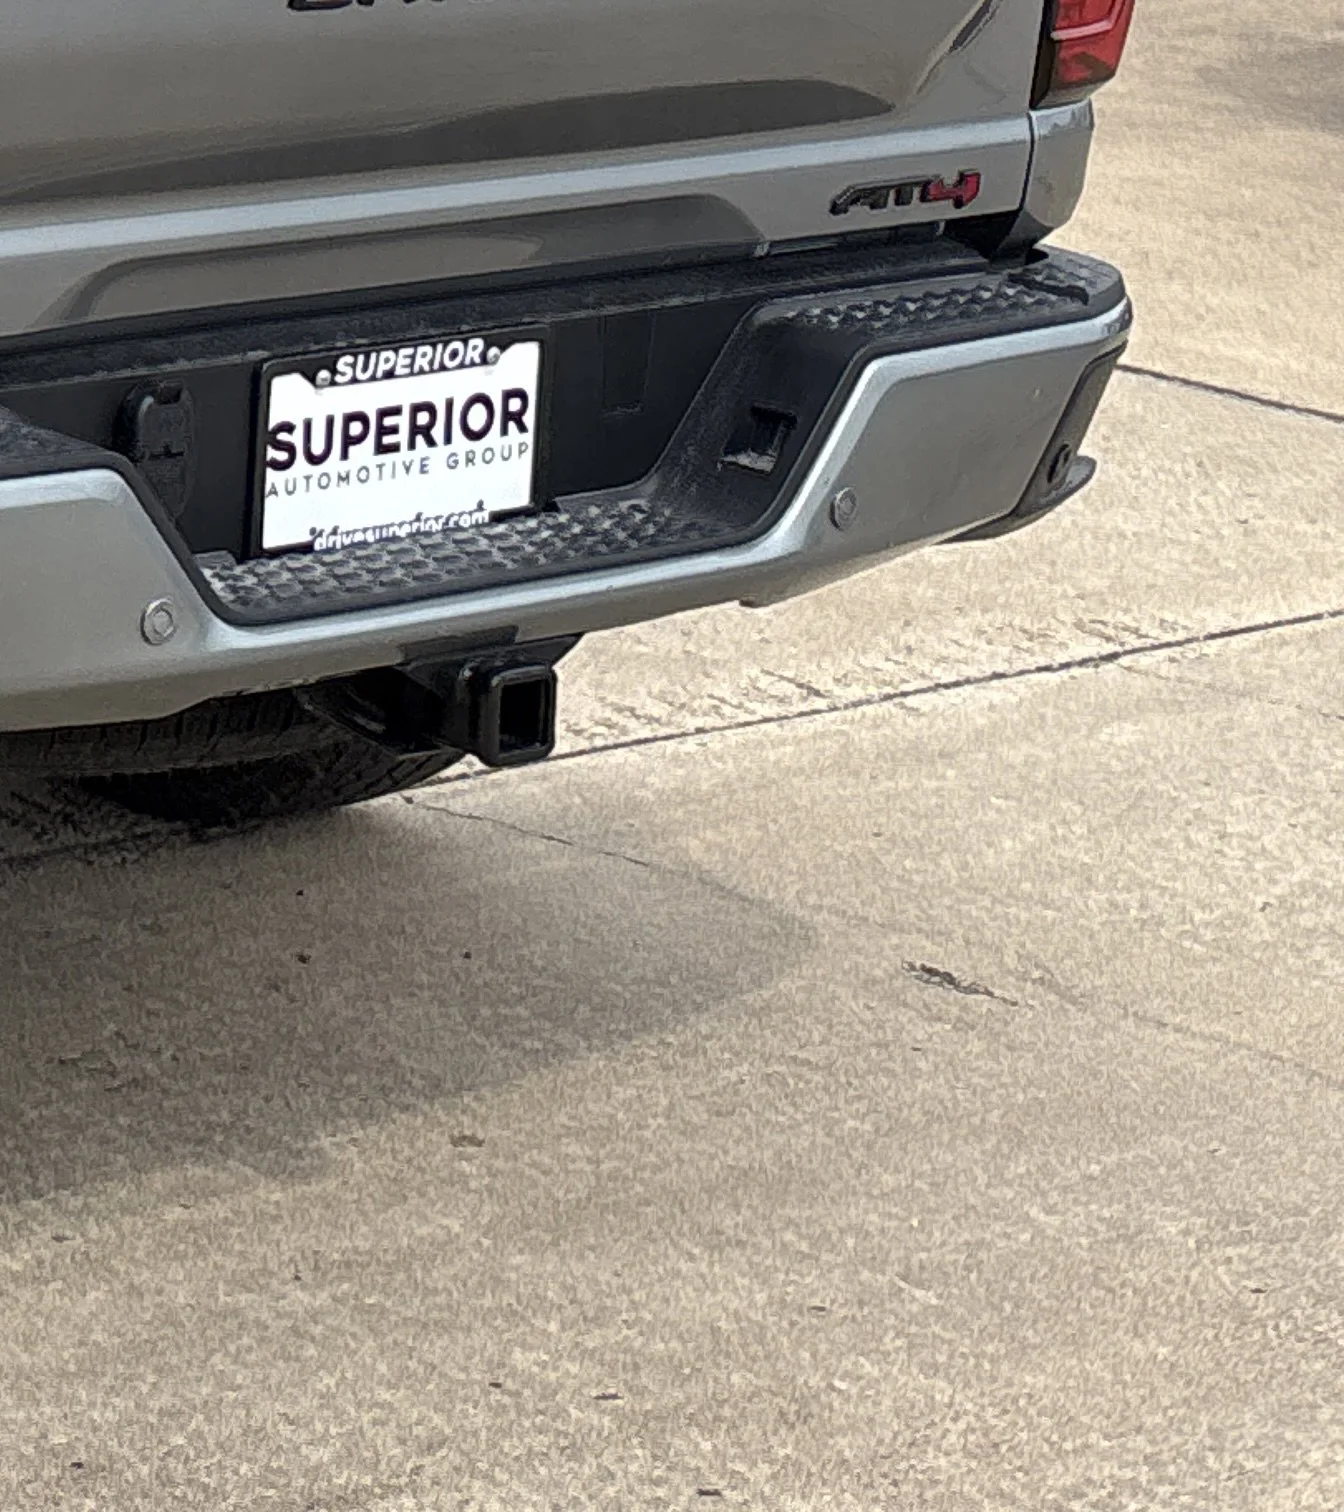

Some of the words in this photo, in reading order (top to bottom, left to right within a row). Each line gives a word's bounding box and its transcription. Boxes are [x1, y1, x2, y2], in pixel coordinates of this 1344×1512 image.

[828, 169, 981, 217] AT4
[334, 338, 485, 383] SUPERIOR
[265, 388, 530, 472] SUPERIOR
[265, 456, 430, 498] AUTOMOTIVE
[446, 442, 529, 470] GROUP
